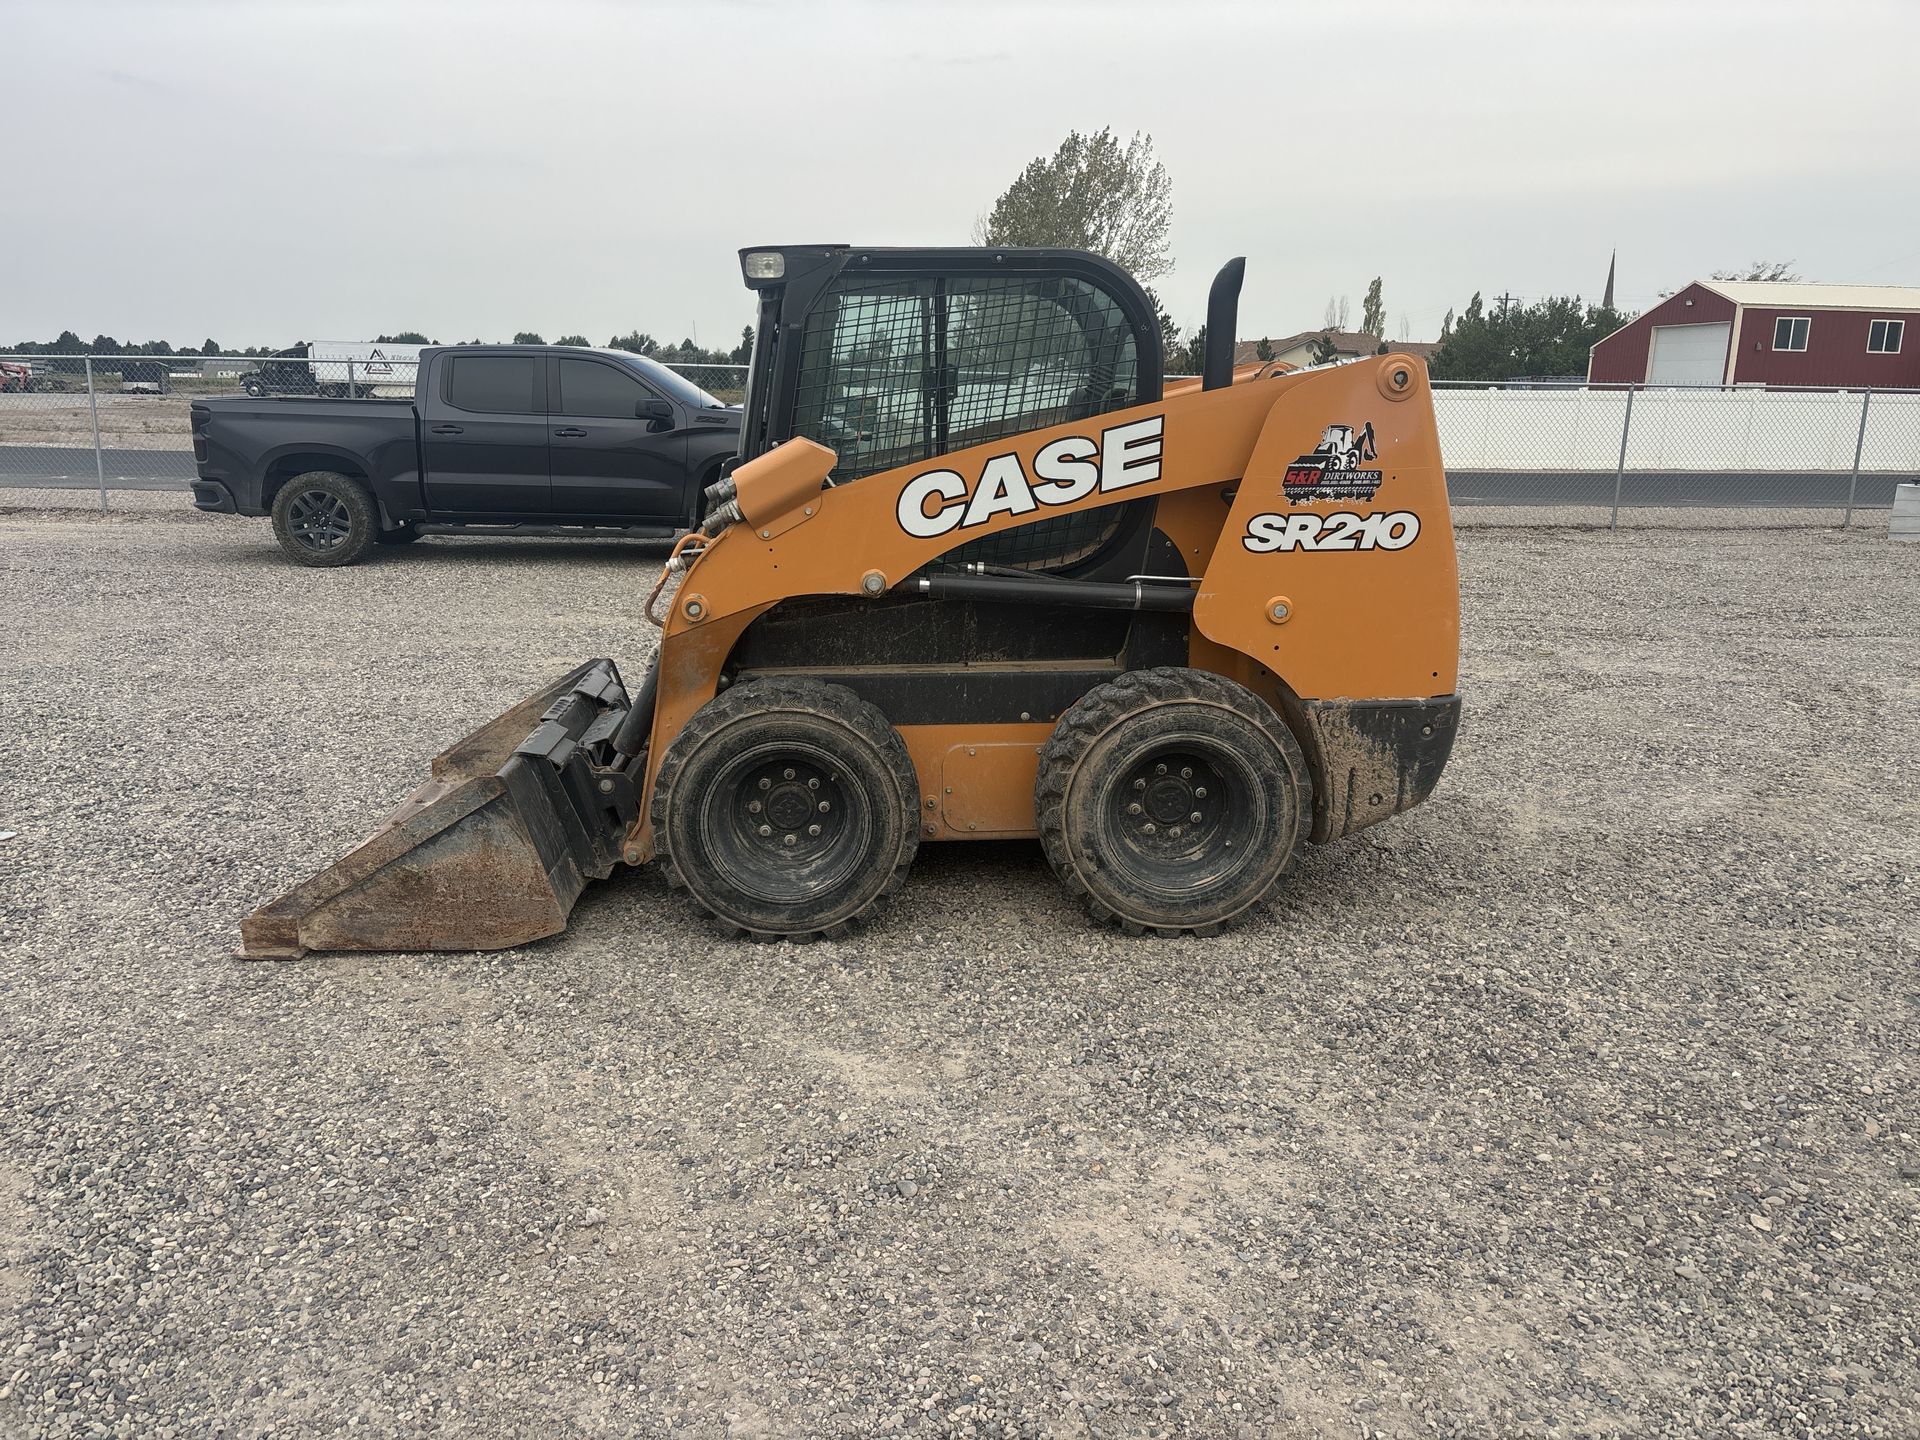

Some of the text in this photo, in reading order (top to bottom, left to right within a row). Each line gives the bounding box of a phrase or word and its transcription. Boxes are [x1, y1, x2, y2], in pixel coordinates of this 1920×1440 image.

[896, 414, 1165, 539] CASE
[1284, 470, 1379, 485] S&R DIRTWORKS
[1242, 511, 1421, 553] SR210
